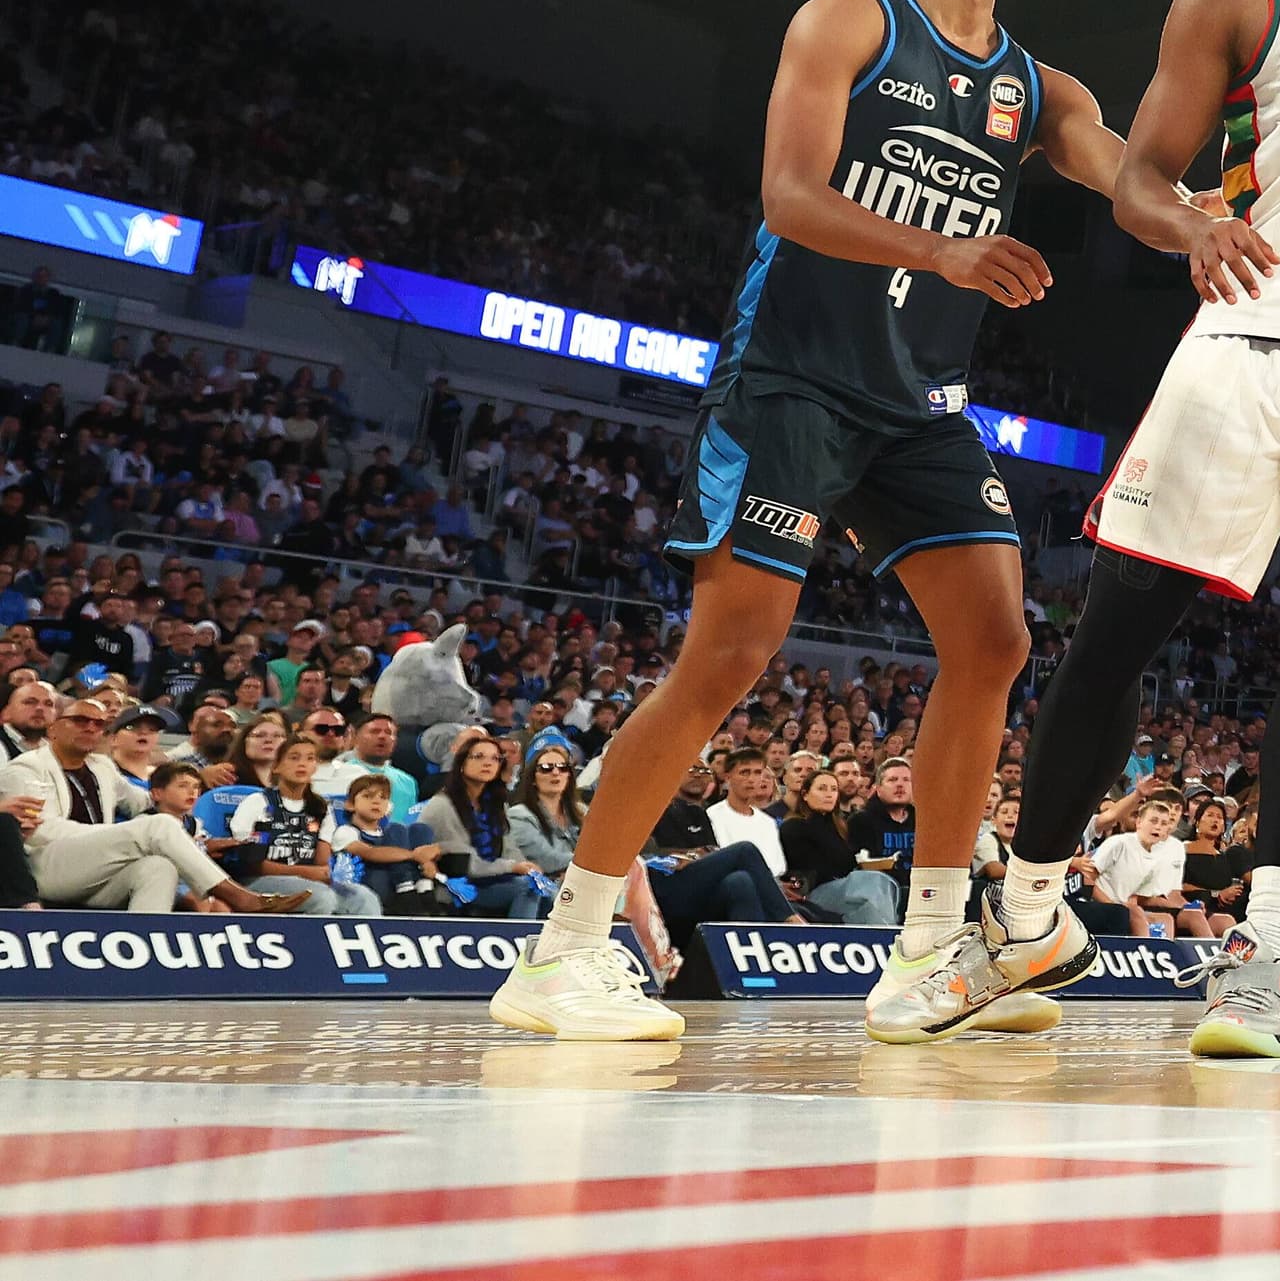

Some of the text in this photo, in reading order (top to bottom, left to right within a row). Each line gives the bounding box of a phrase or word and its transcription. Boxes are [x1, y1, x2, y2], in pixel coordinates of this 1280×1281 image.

[479, 291, 711, 385] OPEN AIR GAME
[0, 923, 294, 970] arcourts
